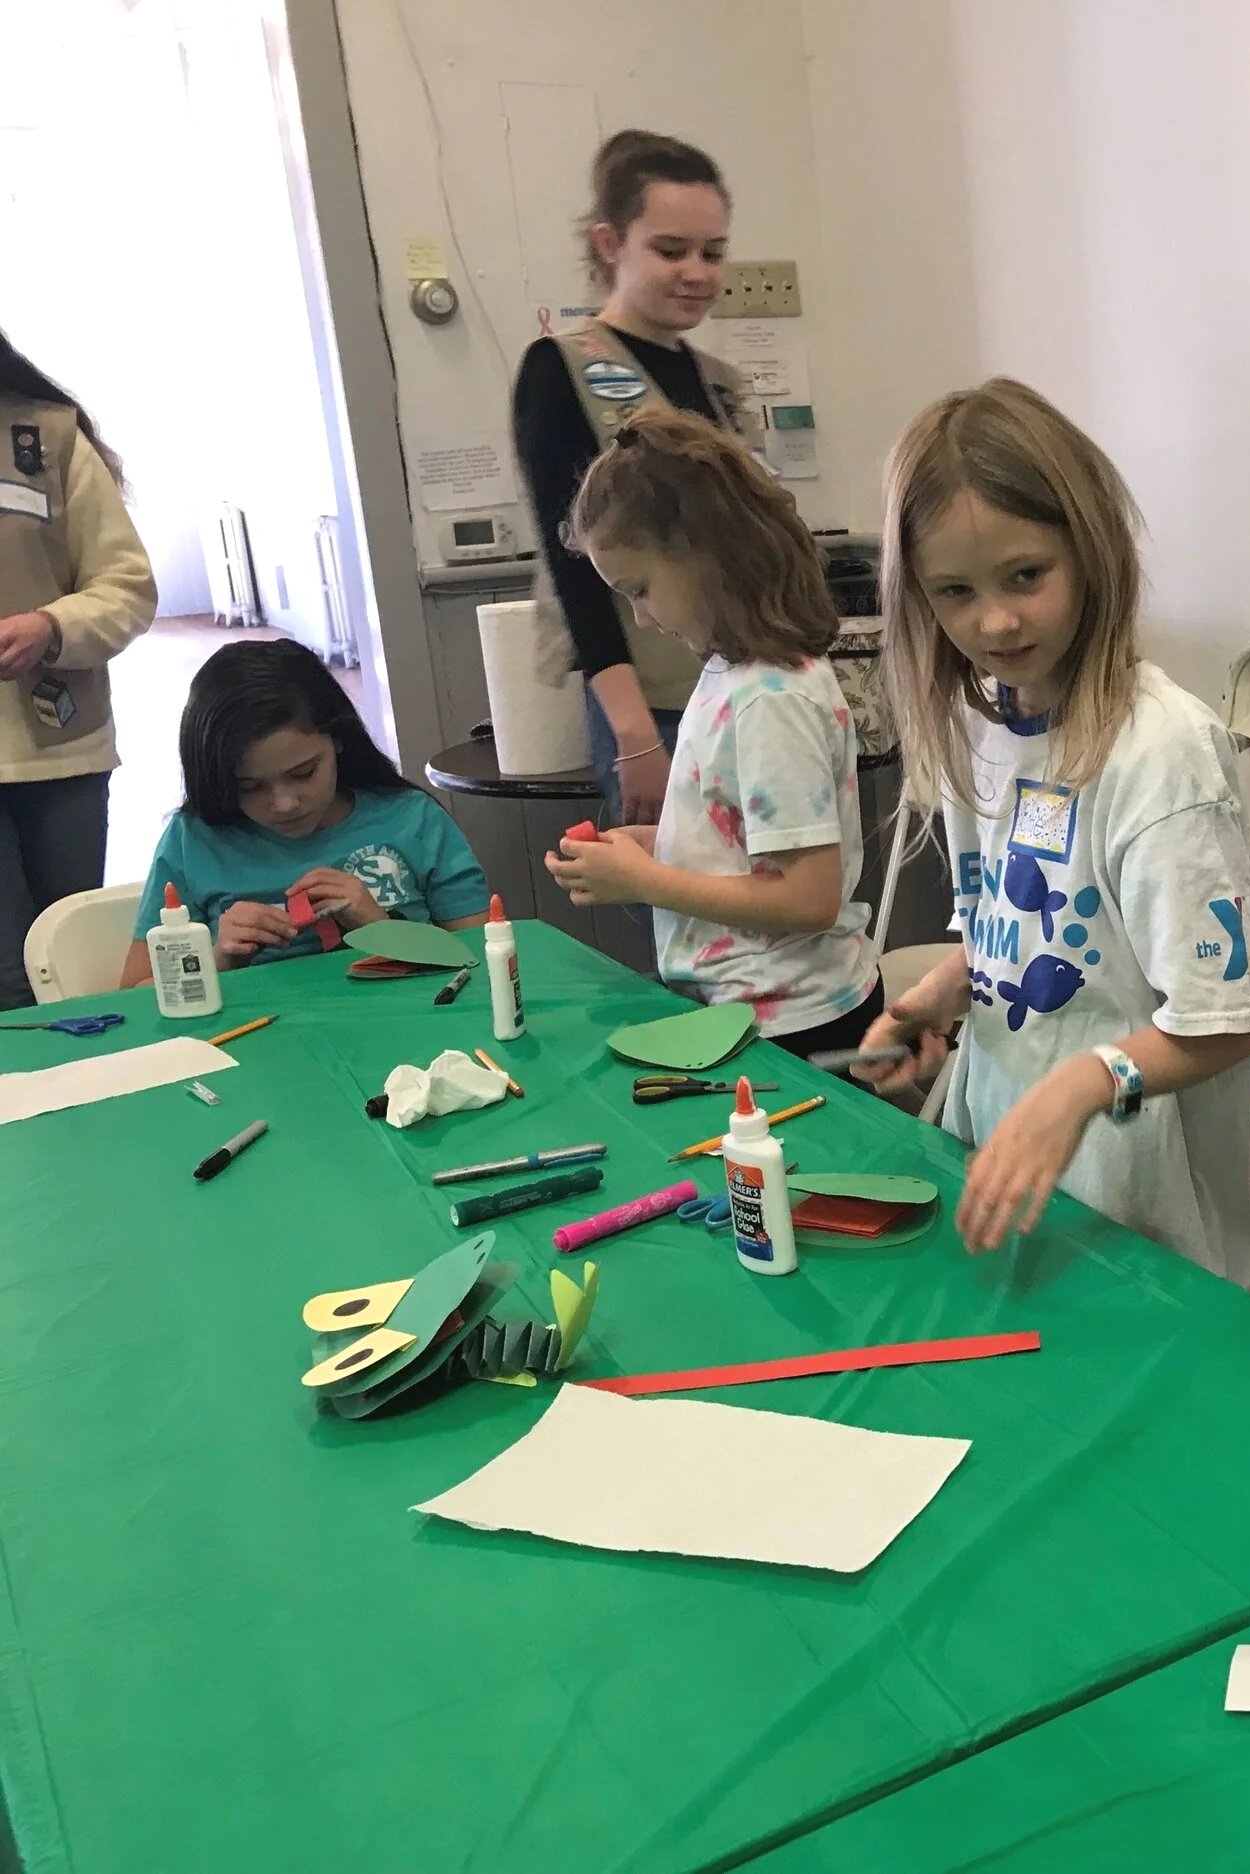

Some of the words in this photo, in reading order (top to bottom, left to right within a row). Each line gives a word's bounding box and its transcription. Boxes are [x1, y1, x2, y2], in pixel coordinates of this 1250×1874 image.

[344, 844, 376, 872] OUTH
[356, 859, 407, 902] SA
[1196, 939, 1221, 958] the
[1208, 896, 1249, 981] Y
[734, 1204, 760, 1224] School
[737, 1217, 755, 1234] Glue
